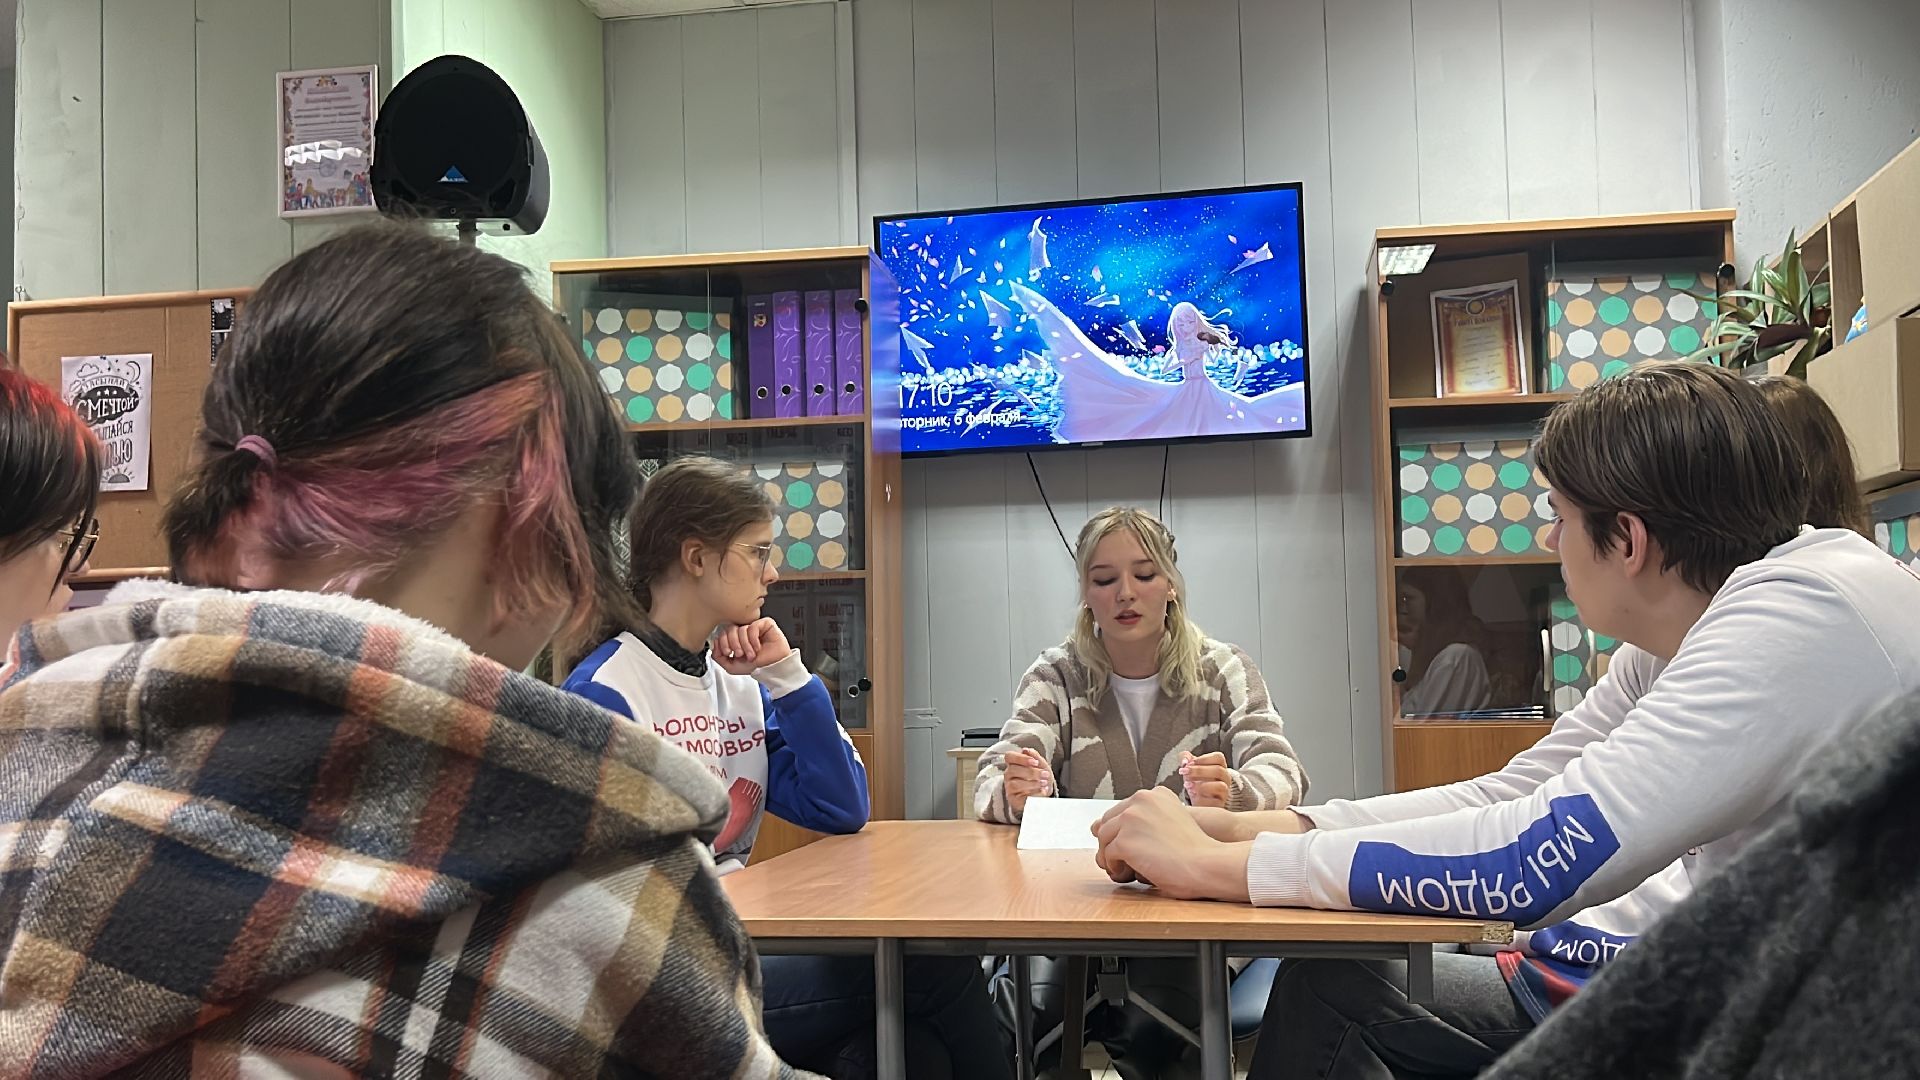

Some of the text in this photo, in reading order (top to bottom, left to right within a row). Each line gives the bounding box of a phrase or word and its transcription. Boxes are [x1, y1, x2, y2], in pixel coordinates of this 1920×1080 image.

[900, 410, 1021, 431] торник, 6 февраля
[1376, 814, 1595, 916] МЫ РЯДОМ
[1550, 936, 1627, 964] ДОМ
